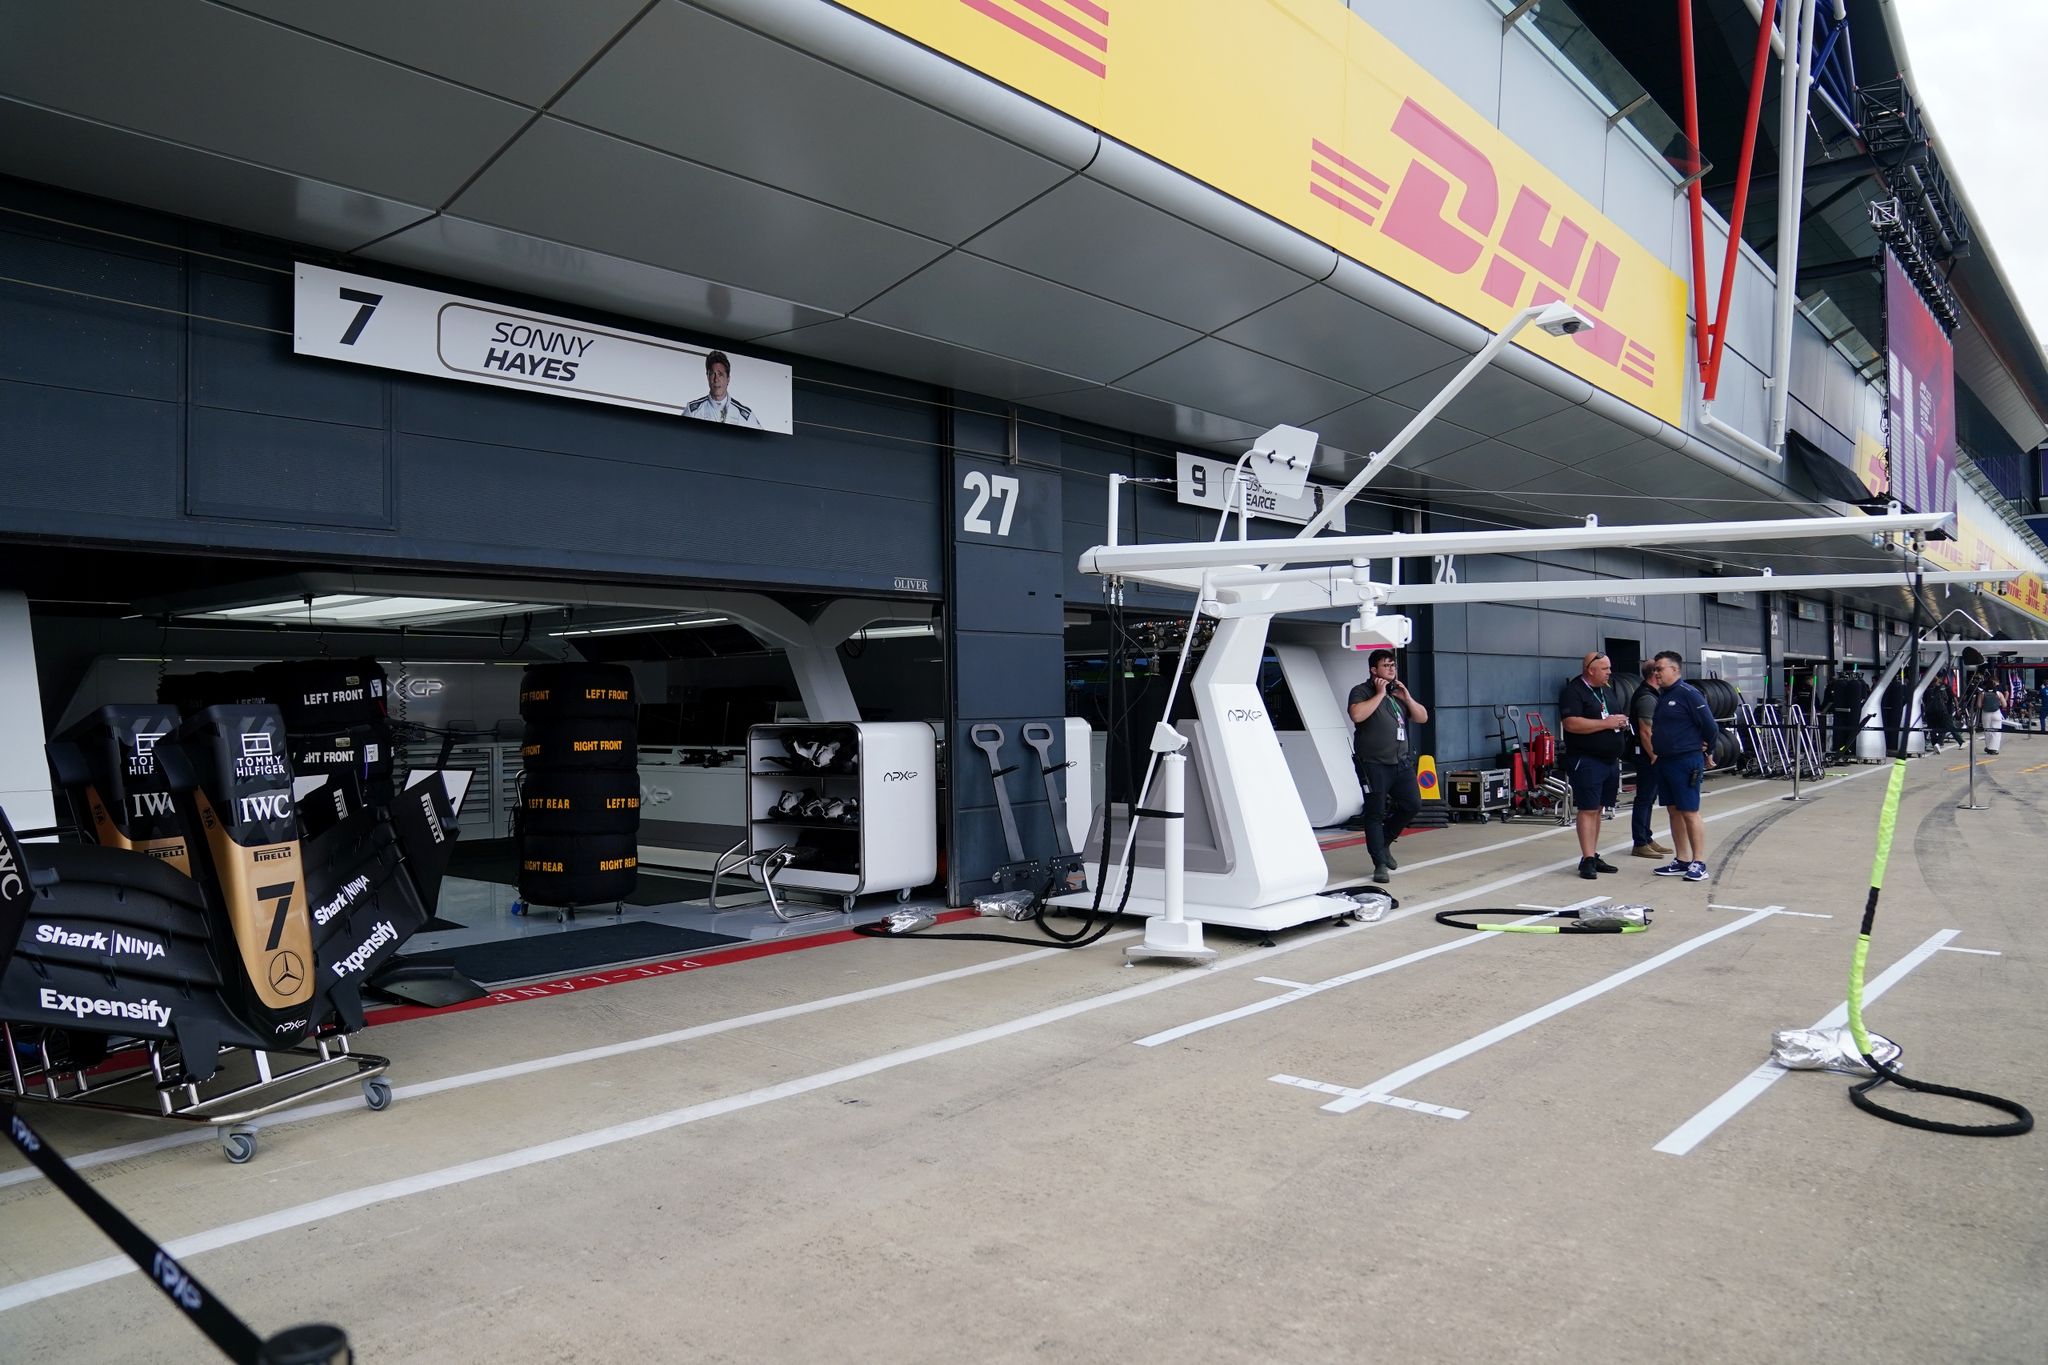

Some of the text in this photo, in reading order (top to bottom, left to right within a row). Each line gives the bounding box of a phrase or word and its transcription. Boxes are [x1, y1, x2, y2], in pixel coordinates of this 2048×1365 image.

[1380, 96, 1627, 367] DHL
[340, 287, 383, 345] 7
[491, 321, 596, 358] SONNY
[483, 347, 579, 382] HAYES
[1191, 464, 1206, 498] 9
[963, 471, 1019, 536] 27
[1246, 493, 1276, 510] EARCE
[1434, 554, 1457, 584] 26
[894, 577, 929, 591] OLIVER
[303, 692, 329, 706] LEFT
[332, 688, 364, 703] FRONT
[585, 688, 629, 701] LEFT FRONT
[323, 750, 355, 763] FRONT
[573, 740, 623, 752] RIGHT FRONT
[129, 765, 154, 775] HILF
[236, 764, 285, 777] HILFIGER
[237, 755, 282, 767] TOMMY
[132, 791, 176, 818] IW
[240, 794, 291, 823] IWC
[332, 788, 349, 821] PIRE
[528, 798, 571, 809] LEFT REAR
[606, 797, 625, 809] LEFT
[420, 792, 445, 844] PIRELLI
[0, 833, 24, 901] WC
[253, 846, 291, 862] PIRELLI
[542, 861, 564, 873] REAR
[600, 859, 624, 871] RIGHT
[314, 874, 371, 926] Shark NINJA
[256, 881, 295, 951] 7
[35, 924, 166, 961] Shark NINJA
[332, 919, 398, 979] Expensify
[40, 988, 172, 1028] Expensify
